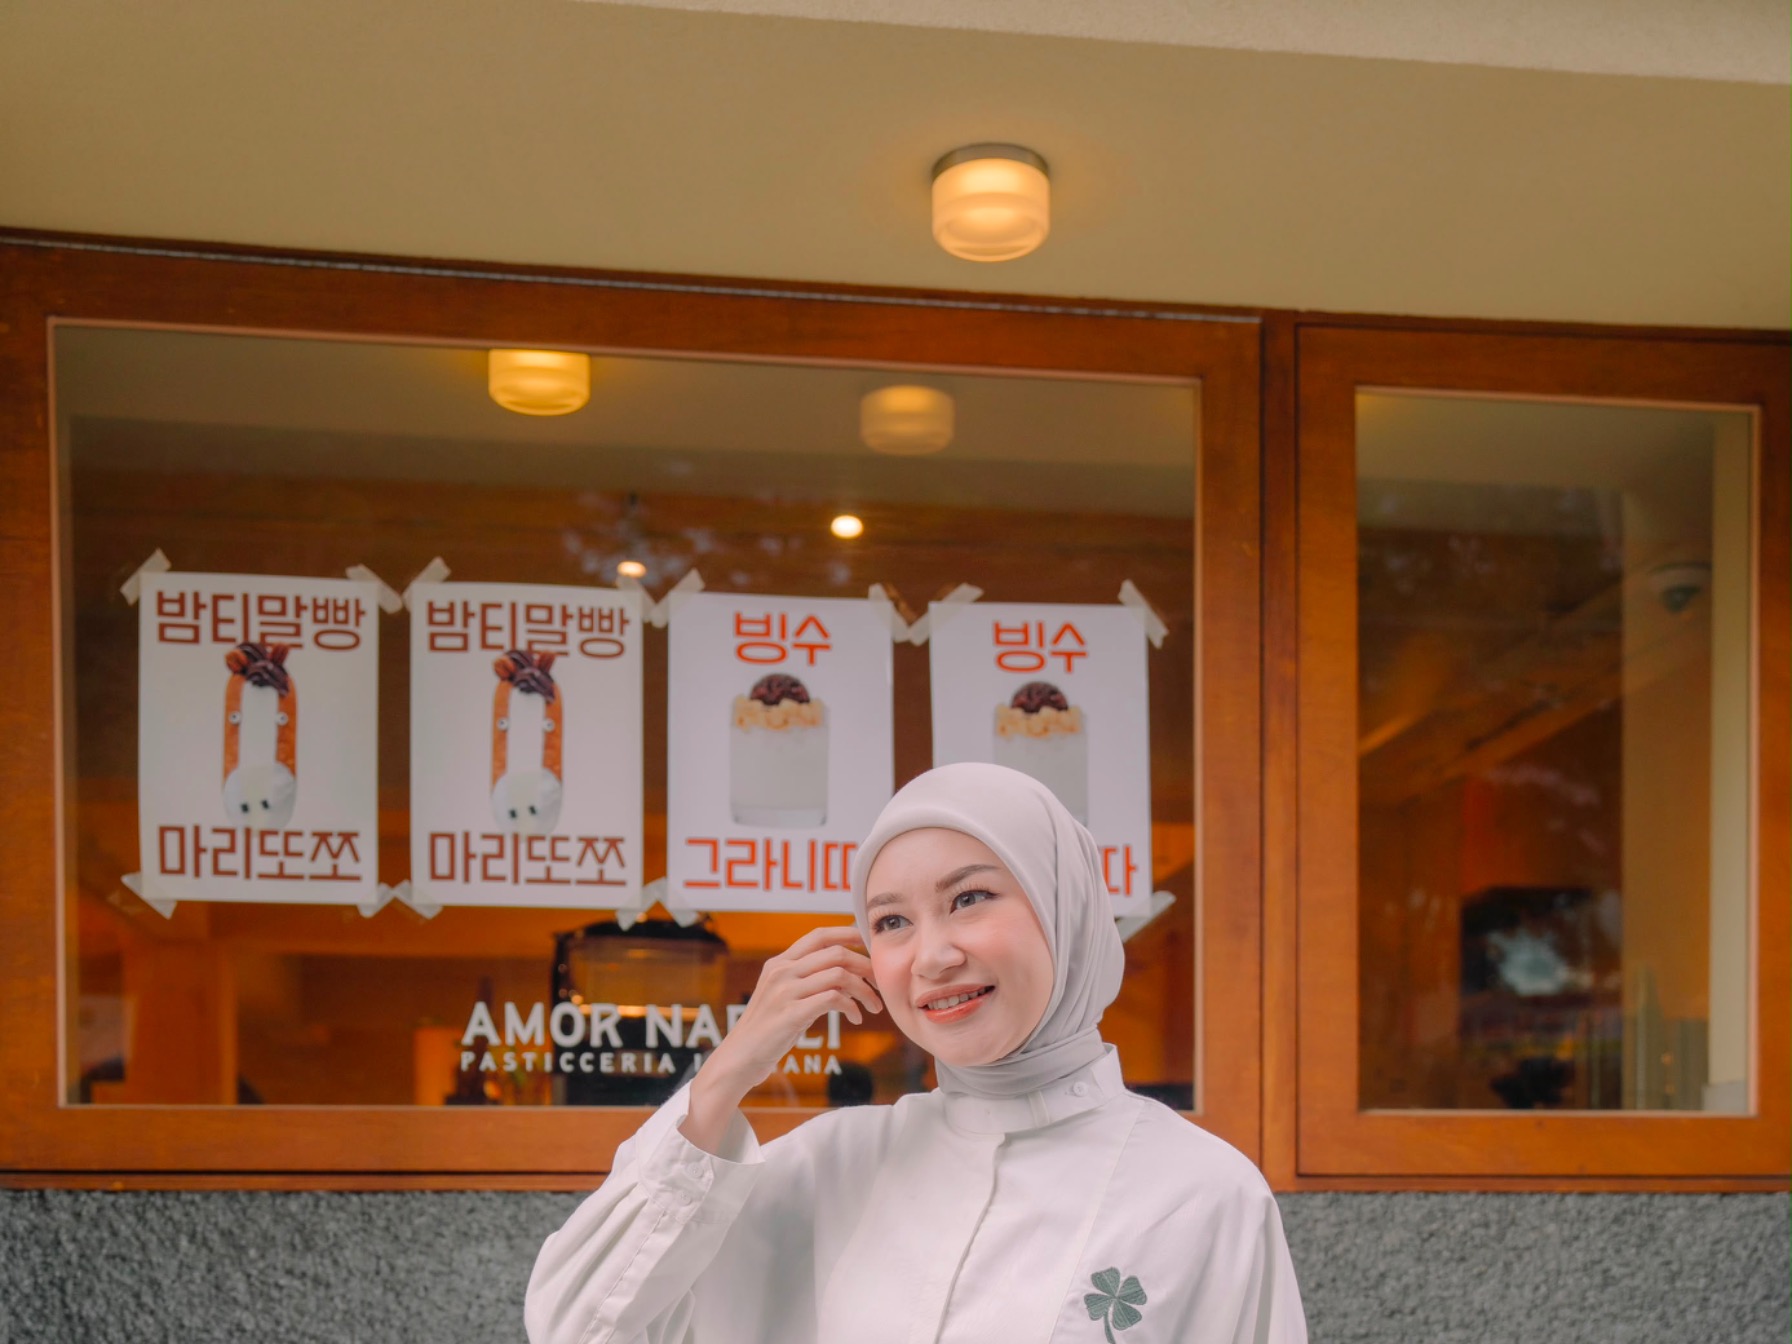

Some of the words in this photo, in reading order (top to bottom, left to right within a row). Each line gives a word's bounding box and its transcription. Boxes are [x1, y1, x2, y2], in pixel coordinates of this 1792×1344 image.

[156, 590, 366, 652] 밤티말빵
[426, 600, 630, 660] 밤티말빵
[733, 611, 832, 666] 빙수
[993, 621, 1088, 674] 빙수
[158, 825, 363, 883] 마리또쪼
[427, 831, 628, 888] 마리또쪼
[461, 1001, 624, 1048] AMOR
[460, 1051, 676, 1074] PASTICCERIA
